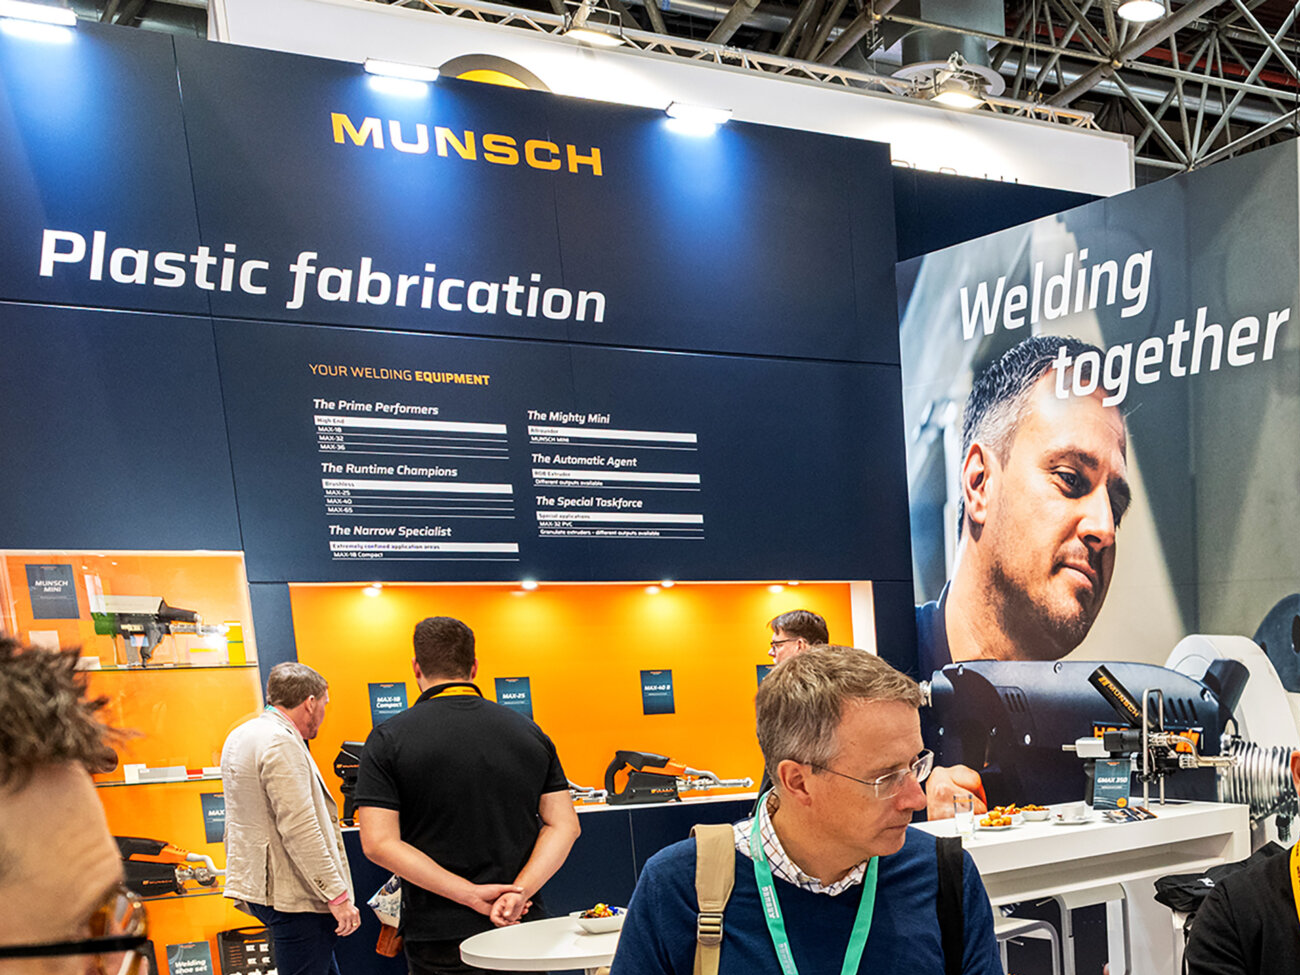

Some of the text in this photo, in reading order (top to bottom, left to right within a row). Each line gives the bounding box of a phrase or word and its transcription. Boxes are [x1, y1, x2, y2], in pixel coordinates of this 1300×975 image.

[331, 112, 603, 177] MUNSCH
[39, 228, 606, 323] Plastic fabrication
[960, 248, 1153, 341] Welding
[1052, 306, 1291, 408] together
[309, 364, 490, 385] YOUR WELDING EQUIPMENT
[313, 399, 439, 415] The Prime Performers
[527, 410, 610, 425] The Mighty Mini
[531, 453, 638, 468] The Automatic Agent
[321, 462, 458, 478] The Runtime Champions
[536, 496, 643, 509] The Special Taskforce
[329, 525, 452, 538] The Narrow Specialist
